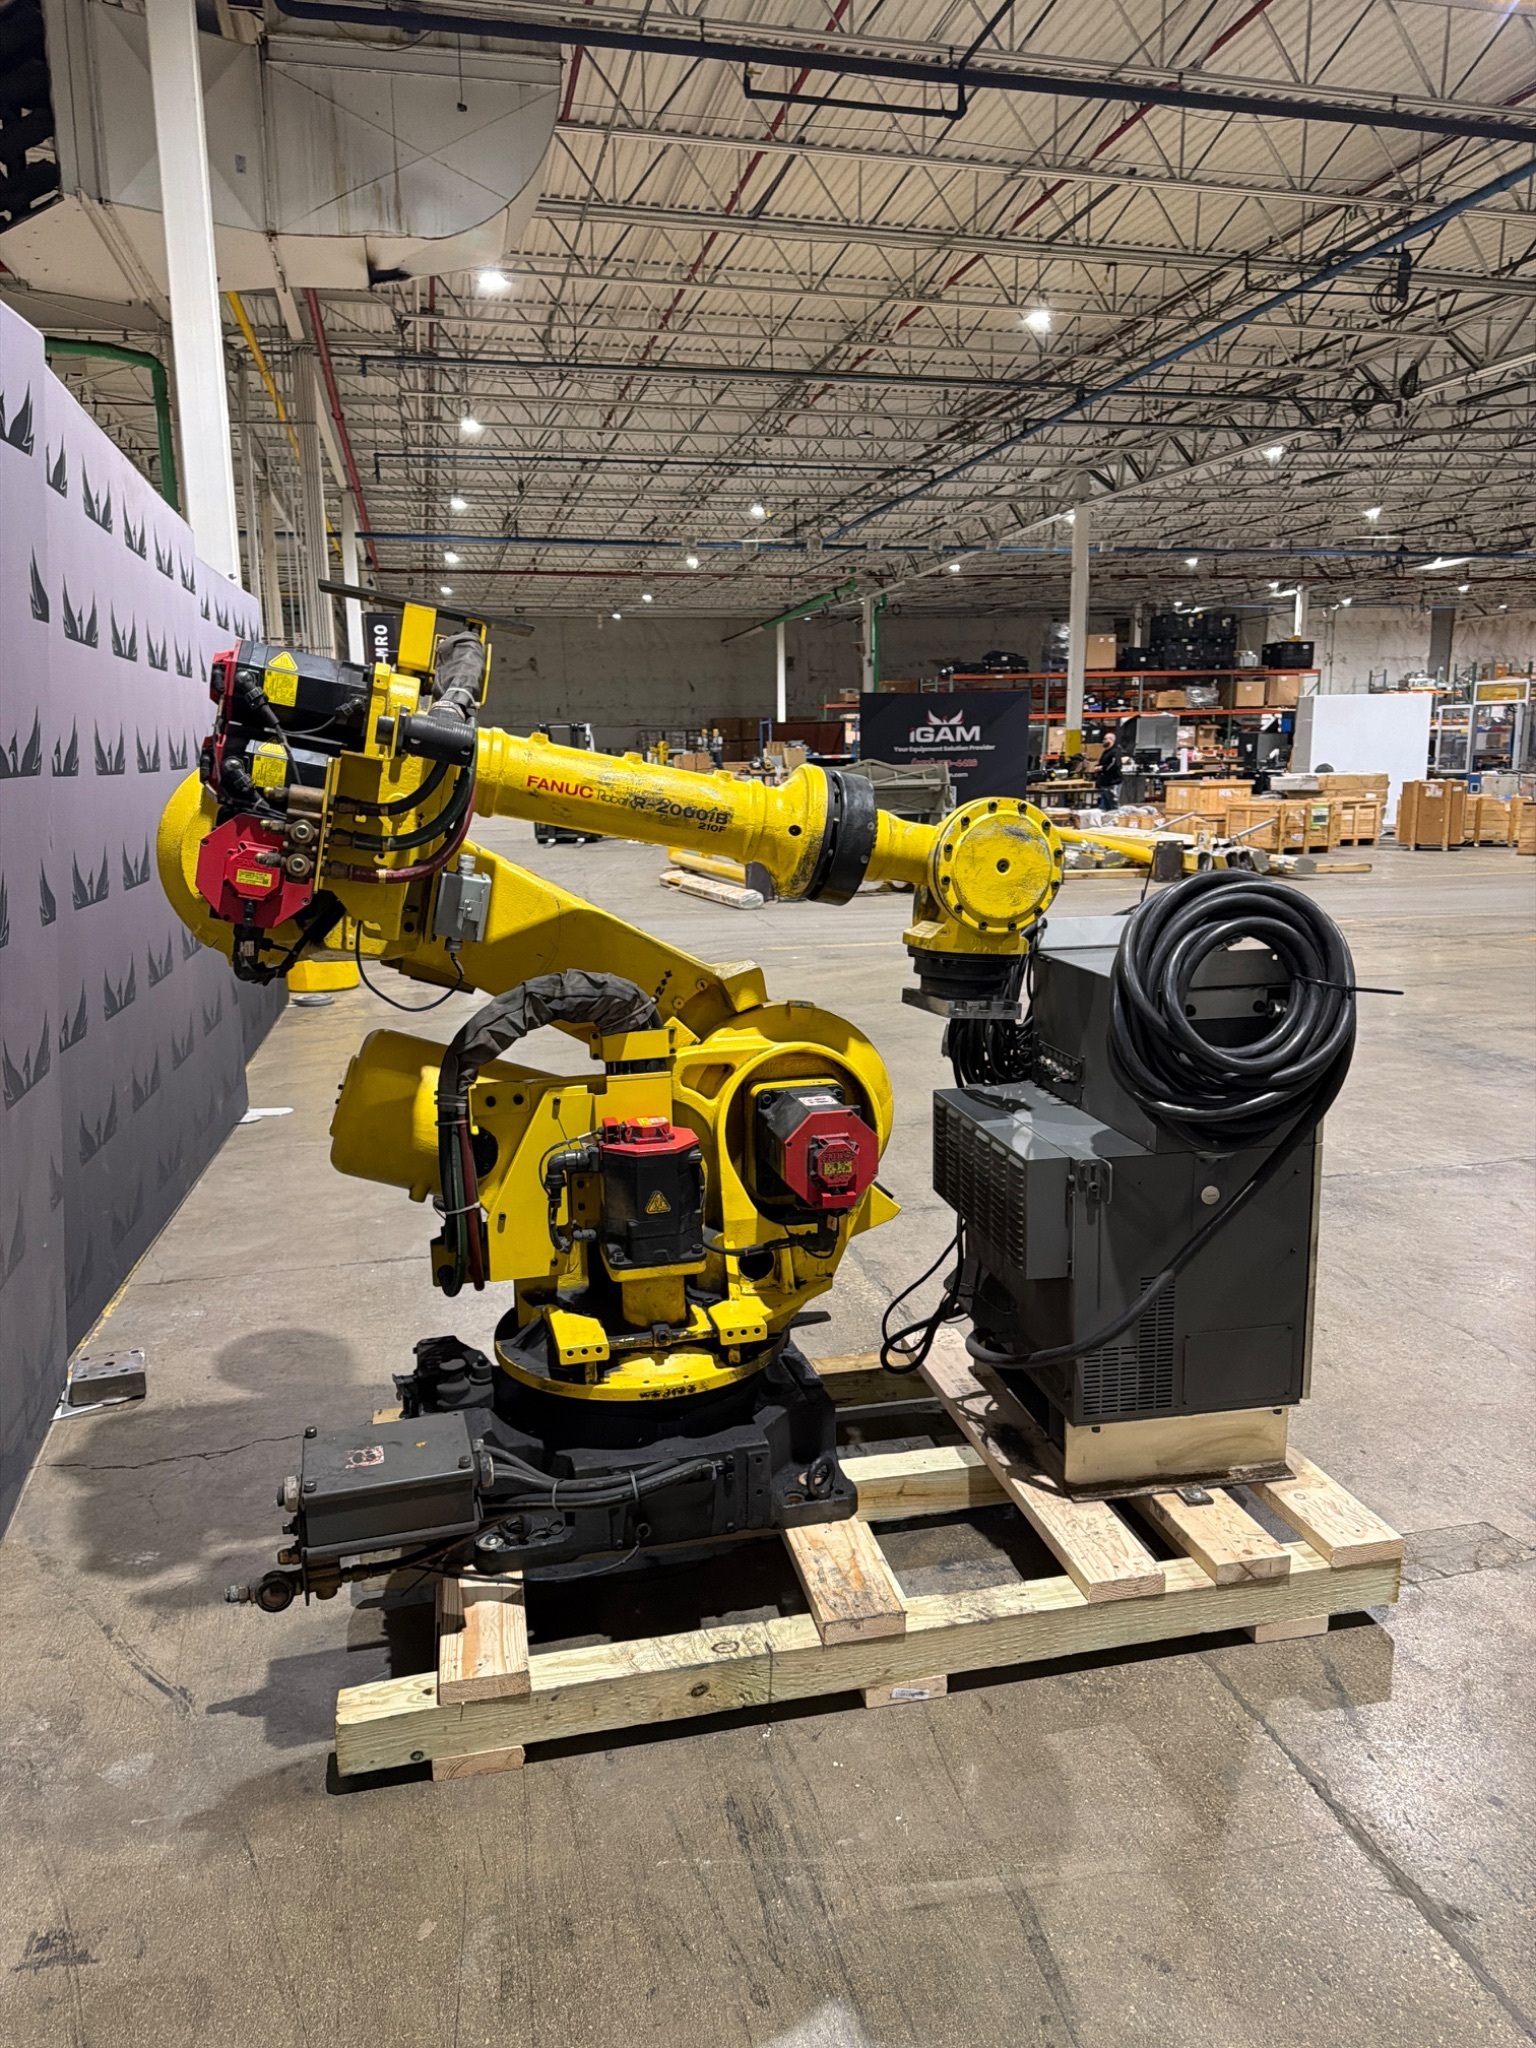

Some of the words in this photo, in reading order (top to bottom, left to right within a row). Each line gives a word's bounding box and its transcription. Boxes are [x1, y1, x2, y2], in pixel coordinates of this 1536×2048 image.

[909, 726, 980, 742] iGAM
[526, 775, 594, 799] FANUC
[697, 822, 728, 834] 210F
